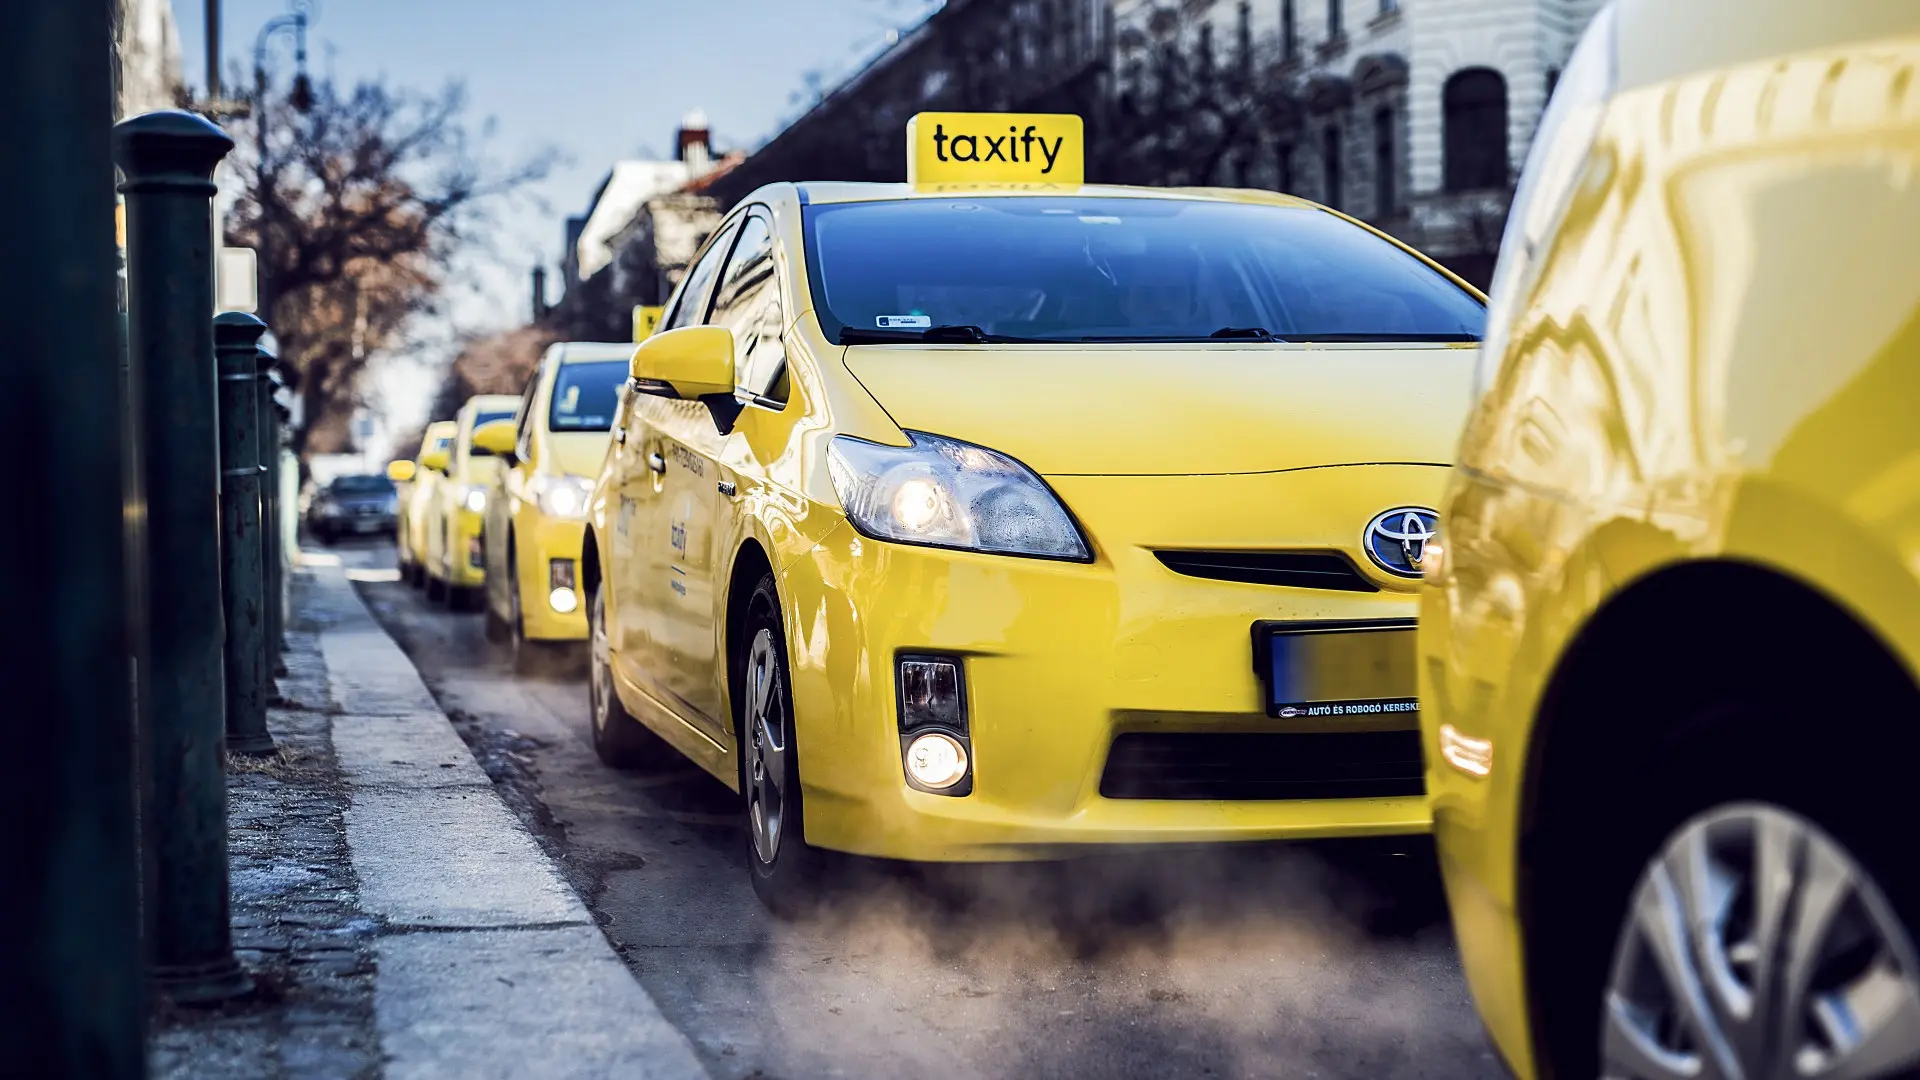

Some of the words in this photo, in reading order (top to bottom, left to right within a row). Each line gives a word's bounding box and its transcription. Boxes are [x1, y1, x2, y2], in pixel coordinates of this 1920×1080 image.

[933, 123, 1063, 174] taxify
[1308, 704, 1331, 716] AUTÓ
[1333, 703, 1344, 714] ÉS
[1346, 702, 1381, 714] ROBOGÓ
